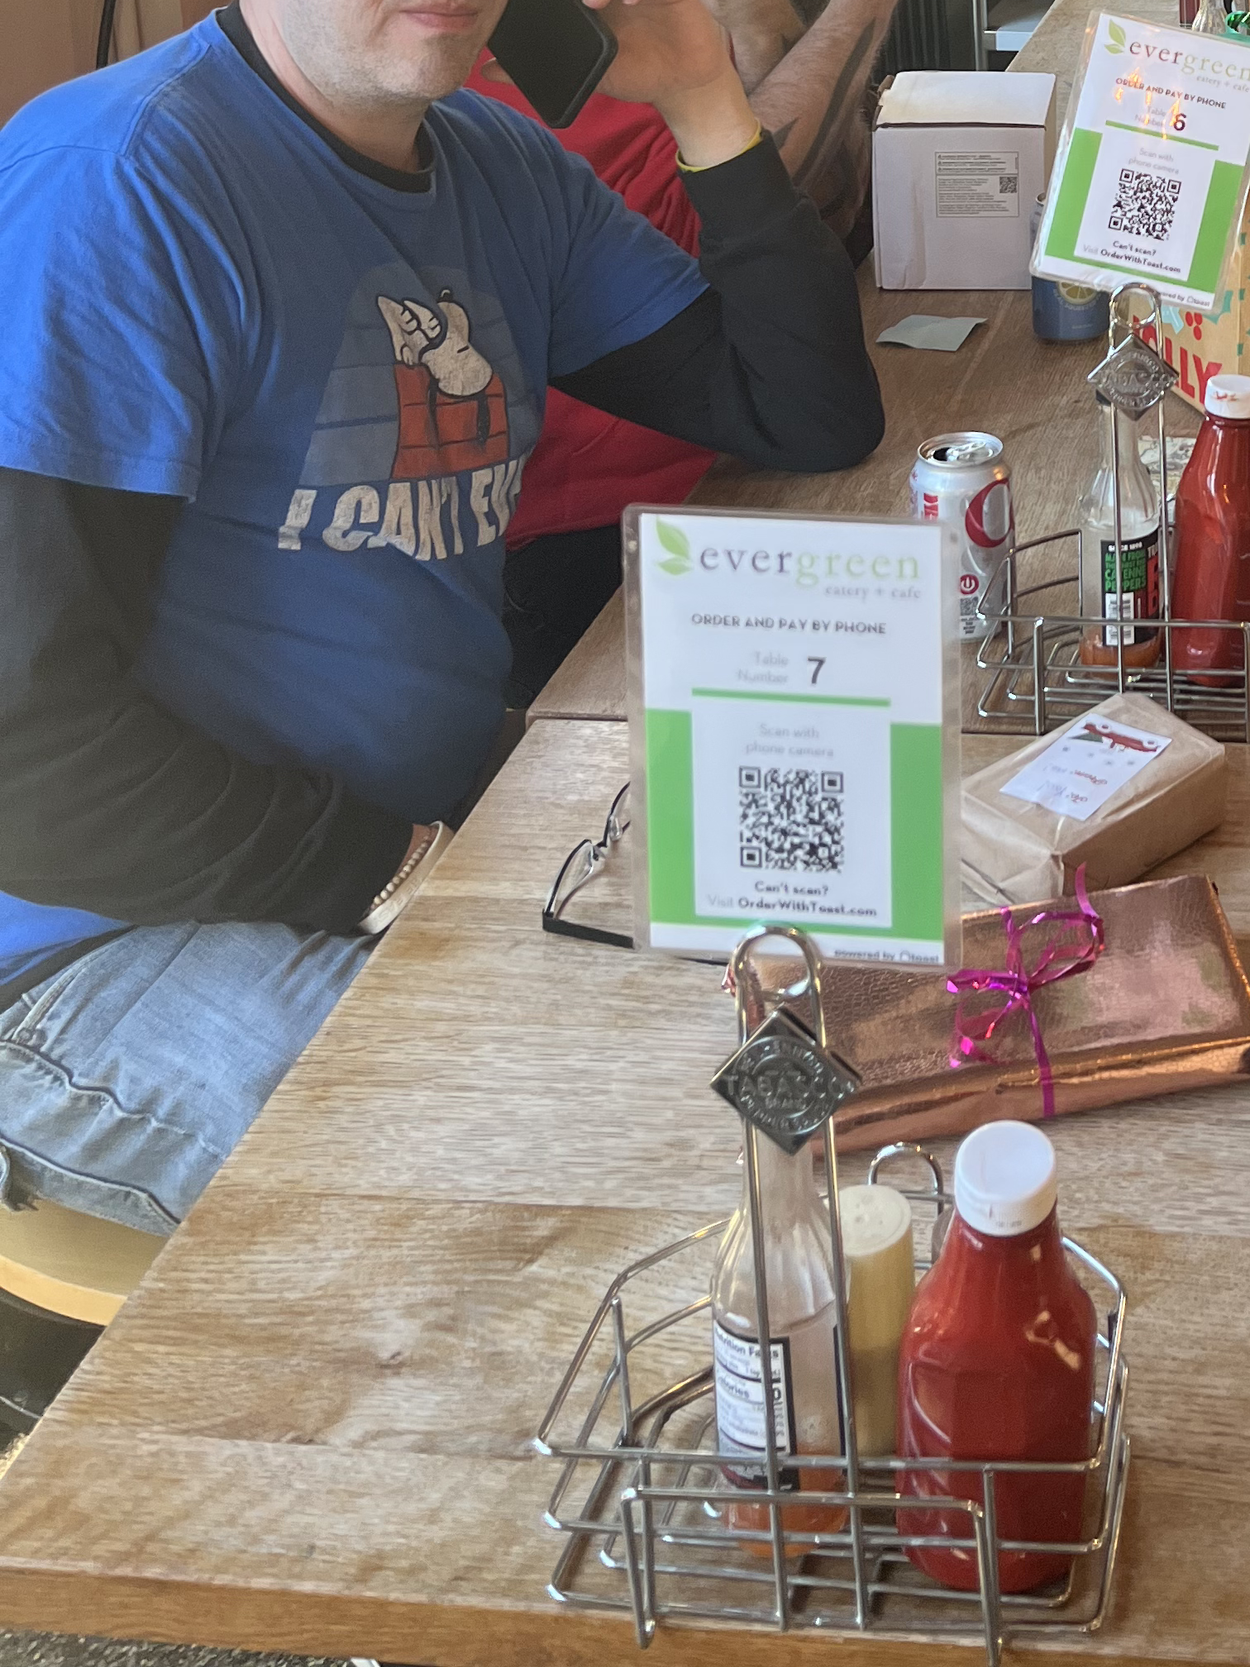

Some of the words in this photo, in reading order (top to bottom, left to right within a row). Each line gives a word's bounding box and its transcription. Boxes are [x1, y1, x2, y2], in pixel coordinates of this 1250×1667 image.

[1196, 76, 1221, 88] eatery
[1233, 83, 1250, 93] cafe
[1116, 78, 1144, 90] ORDER
[1146, 85, 1164, 95] AND
[1165, 88, 1183, 99] PAY
[1184, 93, 1195, 102] BY
[1197, 96, 1227, 109] PHONE
[1173, 113, 1187, 131] 6
[1139, 147, 1156, 158] Scan
[1158, 152, 1174, 162] with
[1128, 157, 1151, 167] phone
[1153, 164, 1179, 174] camera
[1113, 240, 1132, 252] Can't
[1134, 247, 1157, 256] scan?
[1101, 249, 1181, 273] OrderWithToast.com
[1133, 315, 1222, 405] OLLY
[700, 546, 920, 588] evergreen
[1105, 567, 1146, 580] CAENNE
[1106, 577, 1146, 592] PEPERS
[891, 586, 922, 600] cafe
[691, 613, 740, 628] ORDER
[744, 616, 774, 630] AND
[779, 617, 808, 630] PAY
[812, 620, 830, 632] BY
[835, 621, 886, 634] PHONE
[754, 651, 789, 666] Table
[736, 668, 789, 684] Number
[807, 656, 827, 685] 7
[760, 724, 790, 738] Scan
[793, 726, 820, 738] with
[746, 742, 785, 756] phone
[789, 746, 834, 758] camera
[755, 881, 789, 894] Can't
[793, 885, 829, 896] scan?
[708, 896, 733, 908] Visit
[738, 897, 877, 917] OrderWithToast.com
[882, 950, 895, 962] by
[910, 952, 939, 963] toast
[750, 1346, 779, 1359] Fas
